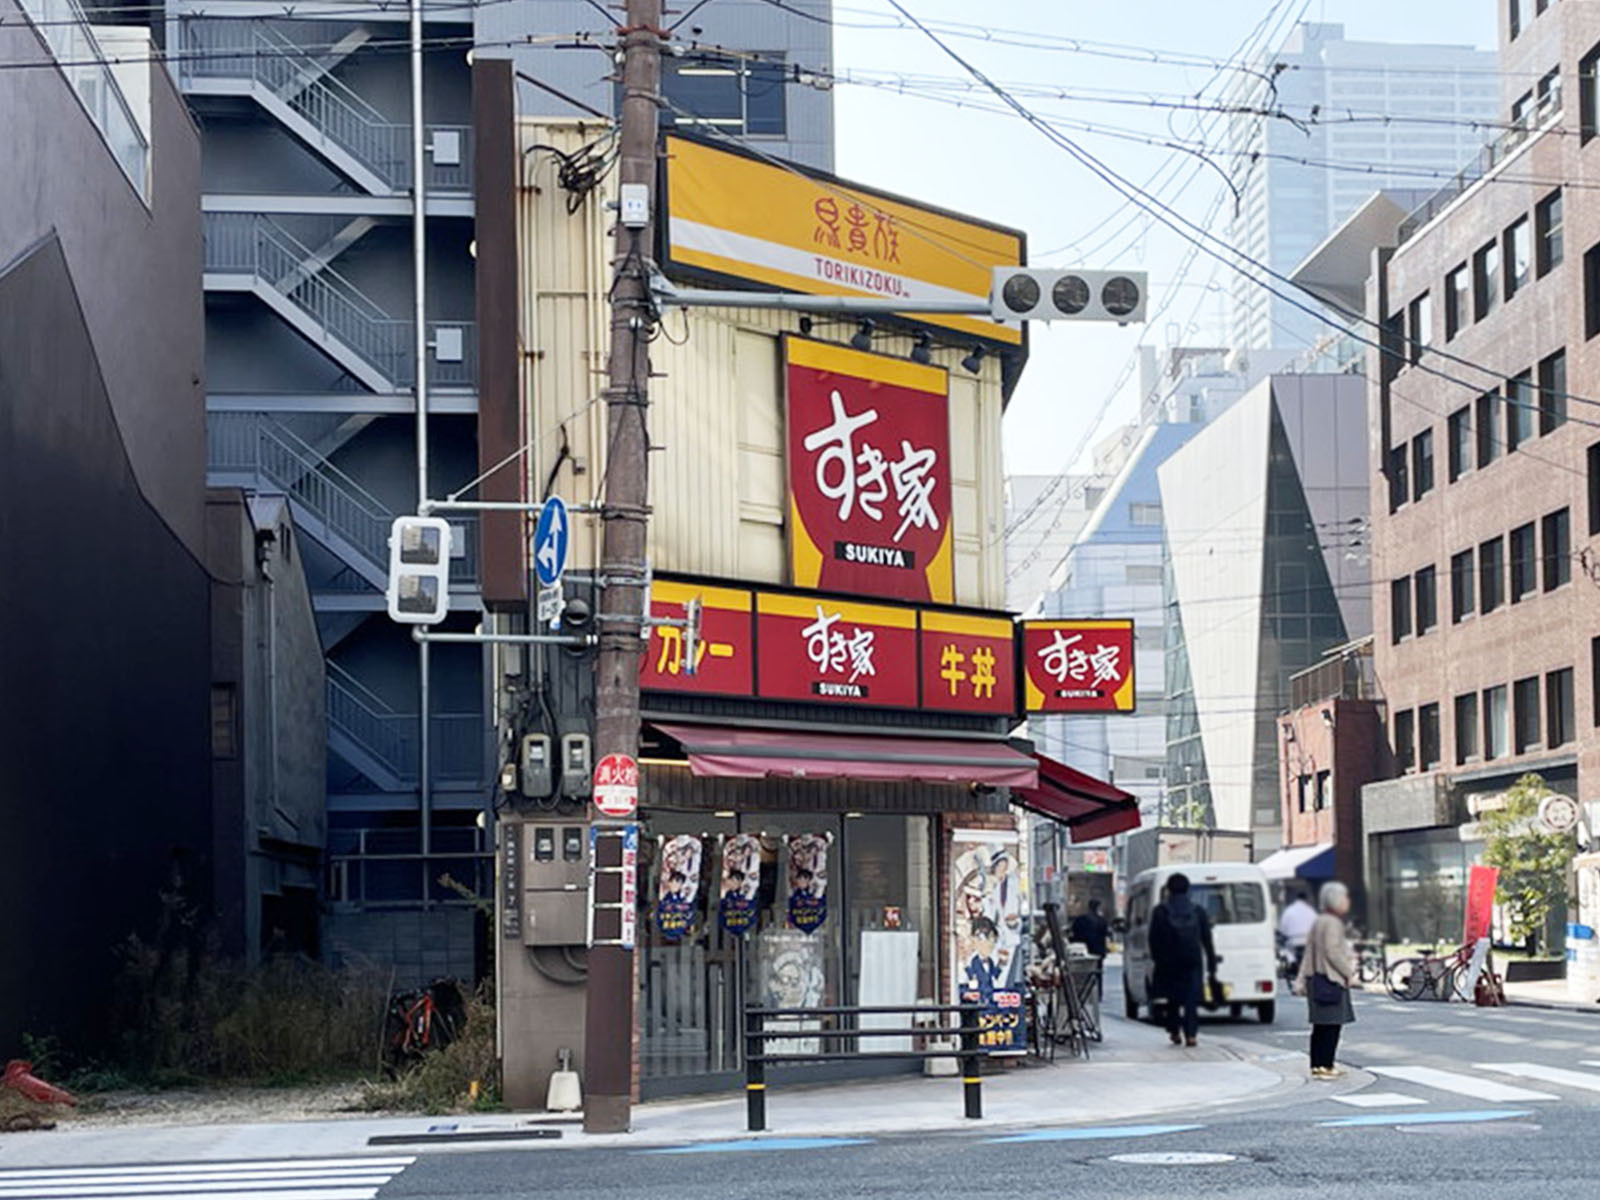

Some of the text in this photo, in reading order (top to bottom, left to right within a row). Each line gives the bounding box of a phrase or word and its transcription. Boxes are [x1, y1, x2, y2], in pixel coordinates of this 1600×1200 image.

[815, 258, 902, 296] TORIKIZOKU
[804, 390, 939, 543] すき家
[845, 544, 905, 568] SUKIYA
[657, 626, 734, 675] カー
[802, 605, 876, 683] すき家
[1037, 630, 1121, 688] すき家
[820, 682, 861, 697] SUKIYA
[941, 644, 997, 698] 牛丼
